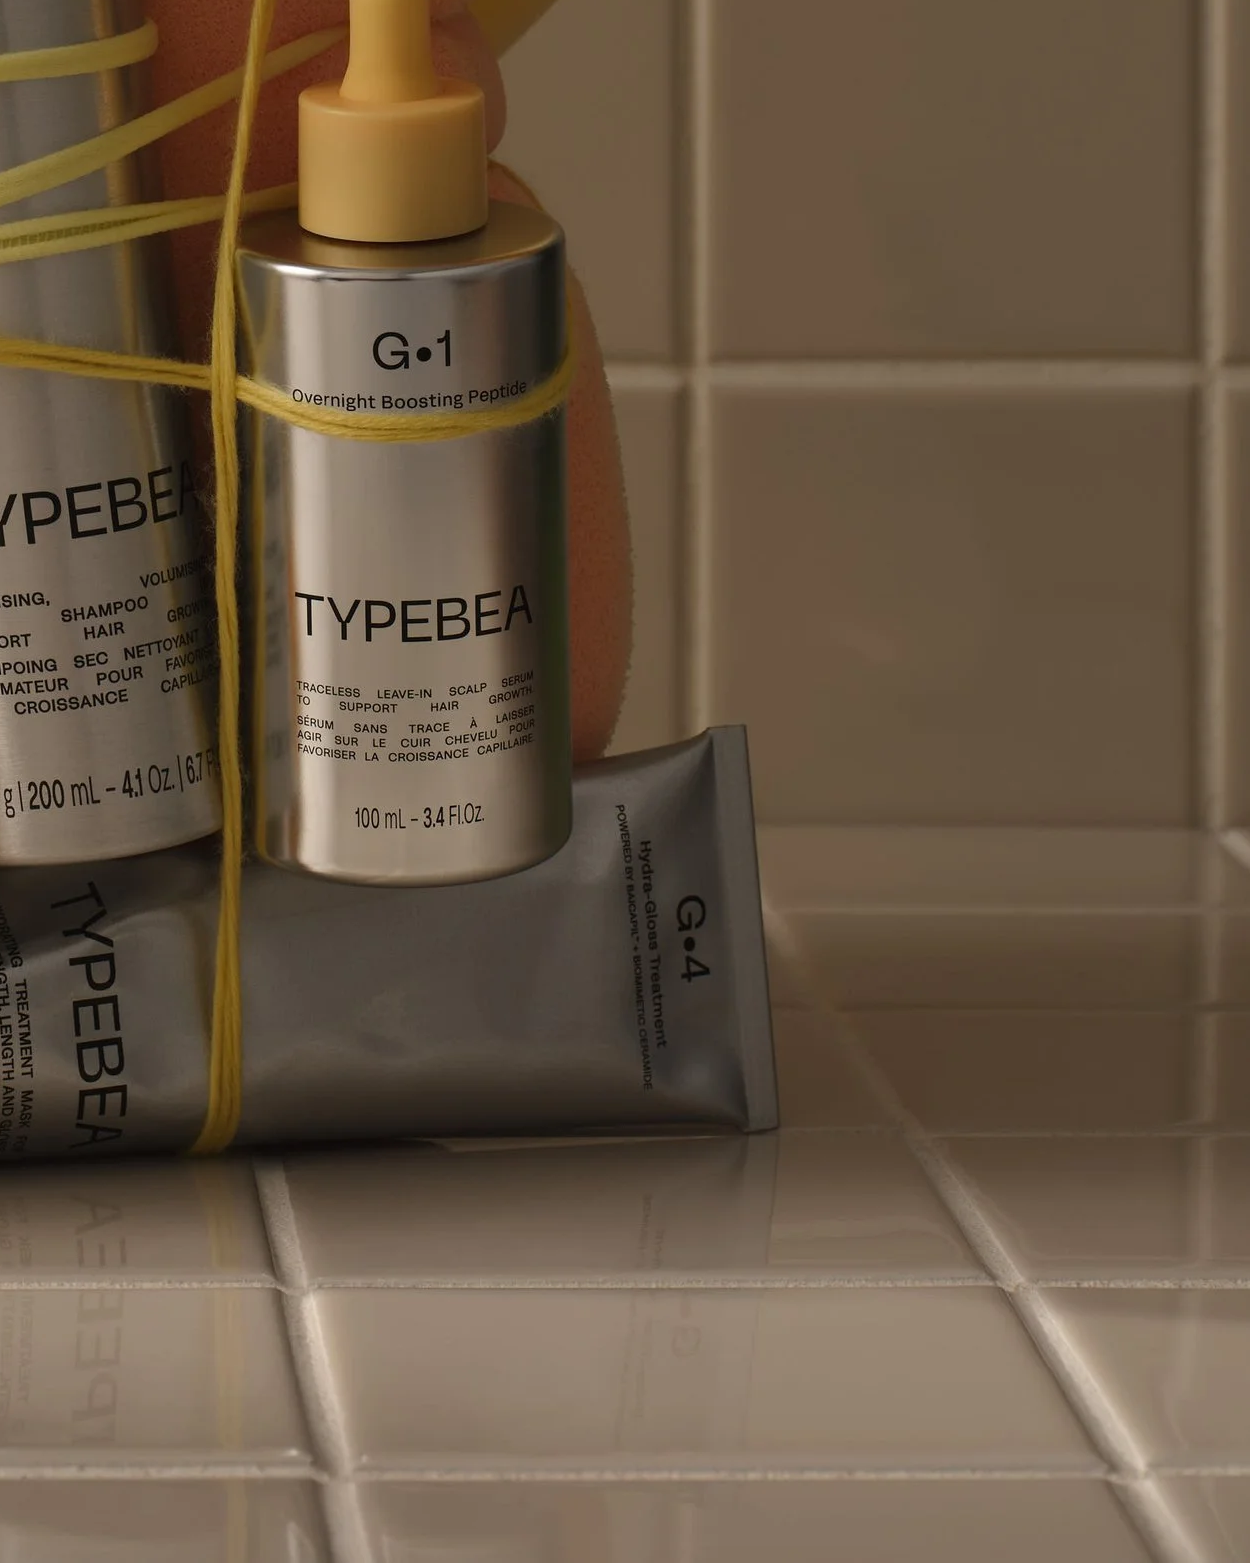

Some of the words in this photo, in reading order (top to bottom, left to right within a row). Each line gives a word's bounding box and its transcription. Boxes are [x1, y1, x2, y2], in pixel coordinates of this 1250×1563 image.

[292, 388, 375, 412] Overnight
[381, 393, 463, 410] Boosting
[468, 379, 527, 404] Peptide
[61, 596, 148, 623] SHAMPOO
[295, 584, 533, 643] TYPEBEA
[83, 621, 125, 640] HAIR
[73, 651, 109, 669] SEC
[123, 628, 200, 661] NETTOYANT
[96, 665, 144, 686] POUR
[296, 680, 360, 698] TRACELESS
[377, 688, 432, 699] LEAVE-IN
[449, 682, 488, 697] SCALP
[501, 670, 534, 687] SERUM
[14, 689, 129, 715] CROISSANCE
[296, 694, 311, 706] TO
[339, 701, 398, 713] SUPPORT
[430, 700, 459, 712] HAIR
[297, 714, 334, 730] SÉRUM
[353, 723, 388, 734] SANS
[409, 722, 450, 733] TRACE
[469, 716, 478, 729] À
[495, 704, 535, 724] LAISSER
[297, 729, 322, 742] AGIR
[334, 735, 359, 747] SUR
[372, 737, 386, 748] LE
[400, 737, 431, 748] CUIR
[445, 728, 498, 747] CHEVELU
[509, 718, 535, 735] POUR
[297, 743, 356, 761] FAVORISER
[364, 752, 379, 762] LA
[388, 747, 469, 762] CROISSANCE
[5, 787, 16, 818] g
[28, 779, 65, 811] 200
[71, 776, 100, 807] mL
[122, 770, 144, 798] 4.1
[150, 764, 176, 792] Oz.
[185, 752, 204, 785] 6.7
[355, 806, 380, 829] 100
[384, 808, 406, 829] mL
[423, 806, 445, 829] 3.4
[615, 804, 632, 864] POWERED
[625, 865, 634, 882] BY
[640, 840, 659, 950] Hydra-Gloss
[632, 955, 646, 1026] BIOMIMETIC
[649, 955, 667, 1049] Treatment
[15, 979, 34, 1078] TREATMENT
[50, 881, 128, 1149] TYPEBEA
[0, 1015, 15, 1081] LENGTH
[638, 1028, 653, 1091] CERAMIDE
[1, 1085, 14, 1117] AND
[20, 1090, 34, 1128] MASK
